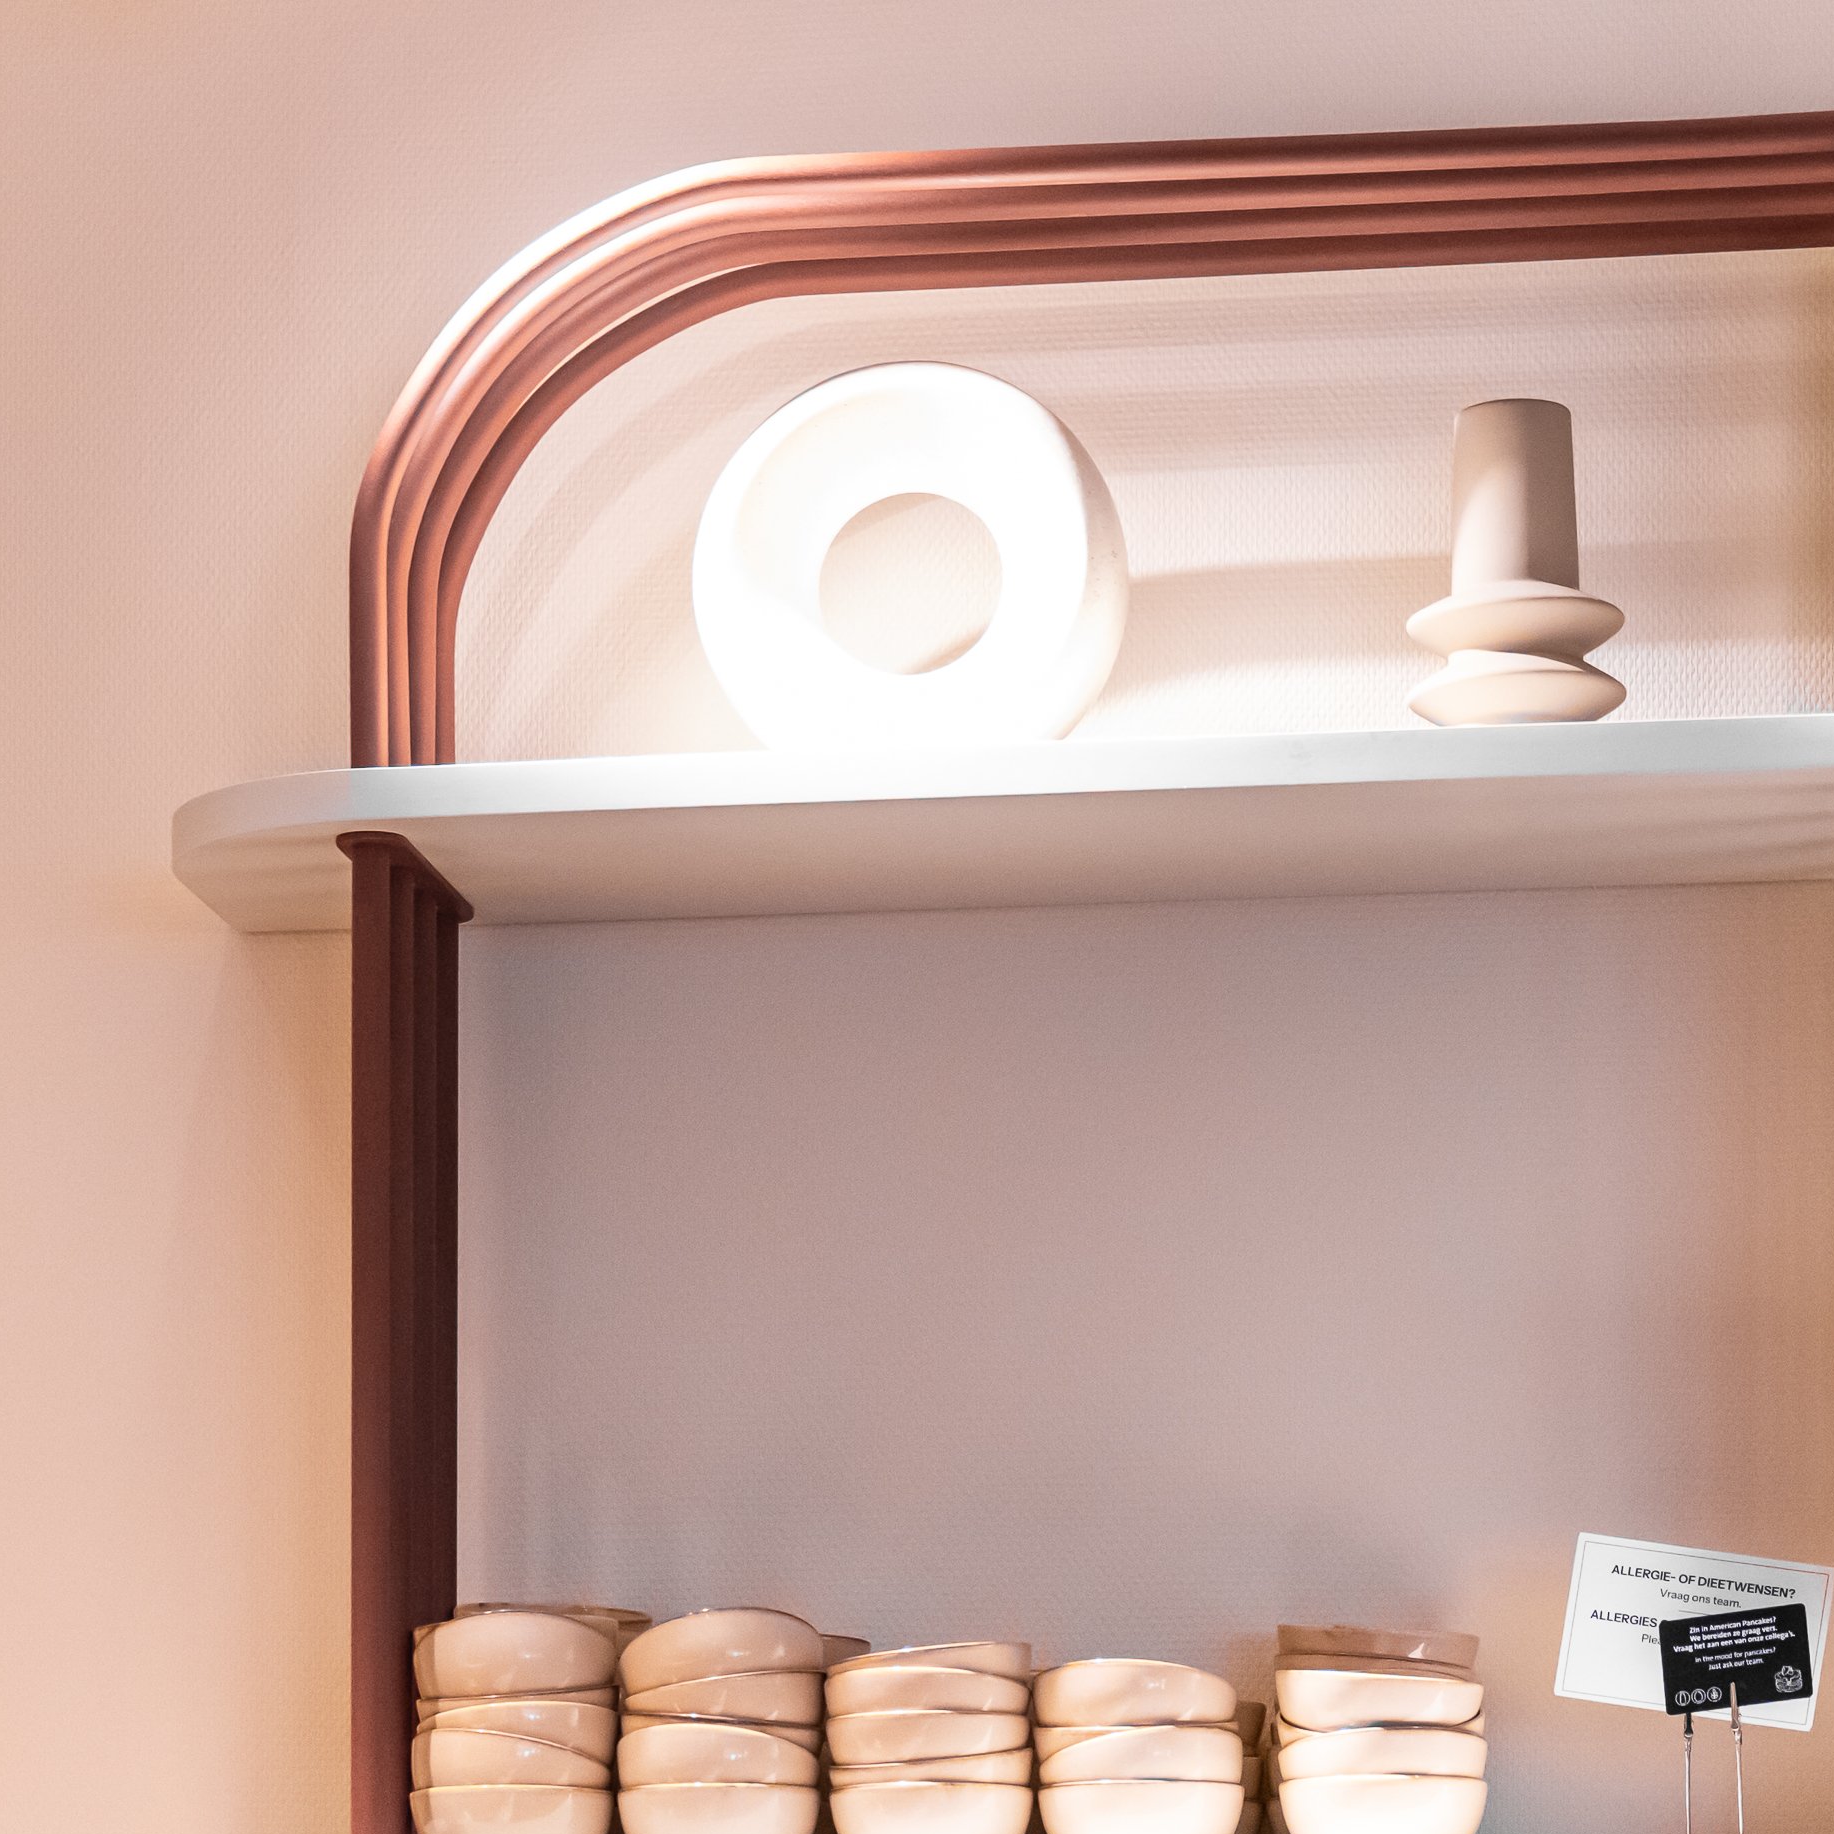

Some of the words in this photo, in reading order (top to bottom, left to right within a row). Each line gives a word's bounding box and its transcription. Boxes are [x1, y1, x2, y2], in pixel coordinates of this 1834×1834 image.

[1612, 1565, 1676, 1582] ALLERGIE-
[1679, 1574, 1696, 1584] OF
[1698, 1577, 1795, 1599] DIEETWENSEN?
[1660, 1589, 1690, 1602] Vraag
[1692, 1595, 1710, 1603] ons
[1714, 1597, 1742, 1608] team.
[1591, 1610, 1657, 1628] ALLERGIES
